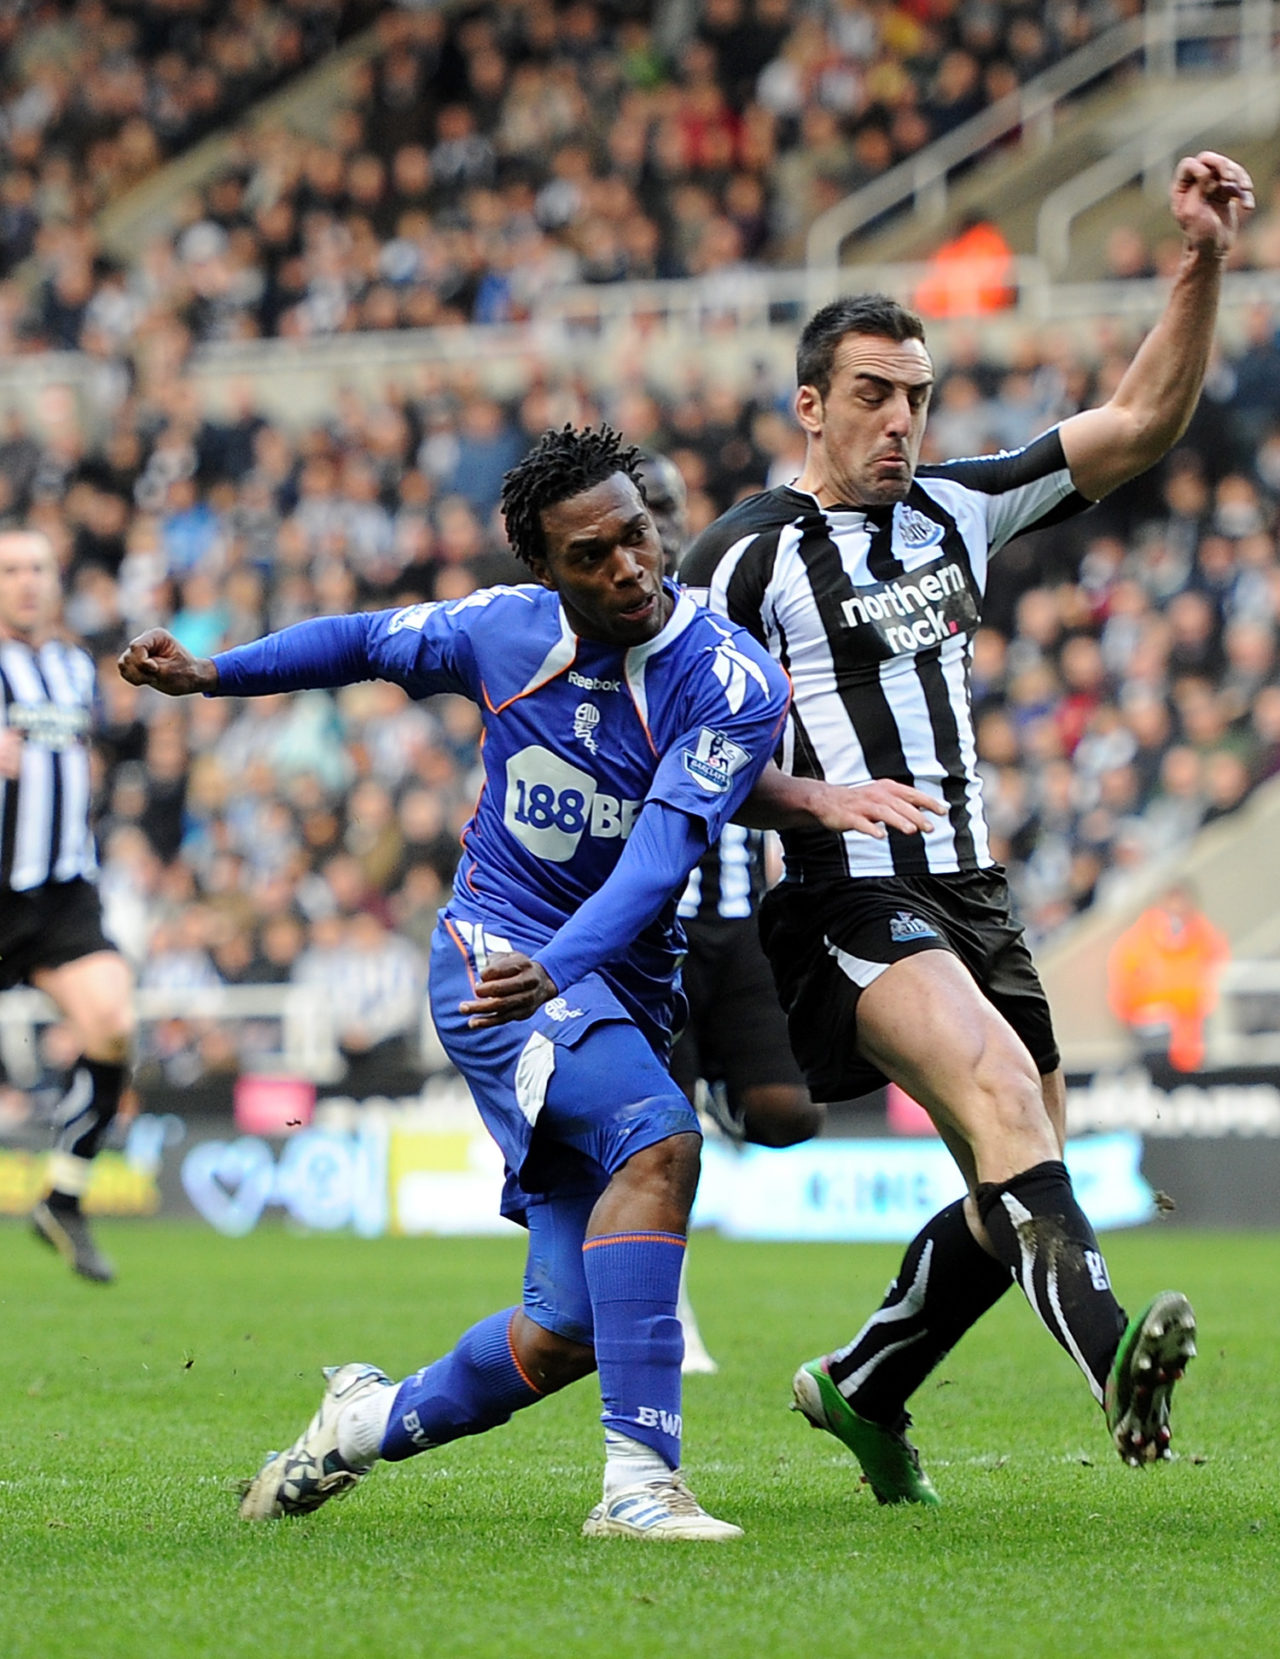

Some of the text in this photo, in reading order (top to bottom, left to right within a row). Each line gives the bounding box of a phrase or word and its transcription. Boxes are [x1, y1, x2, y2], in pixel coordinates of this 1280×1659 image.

[840, 562, 966, 628] northern
[567, 671, 621, 693] Reebok
[514, 778, 645, 840] 188BE
